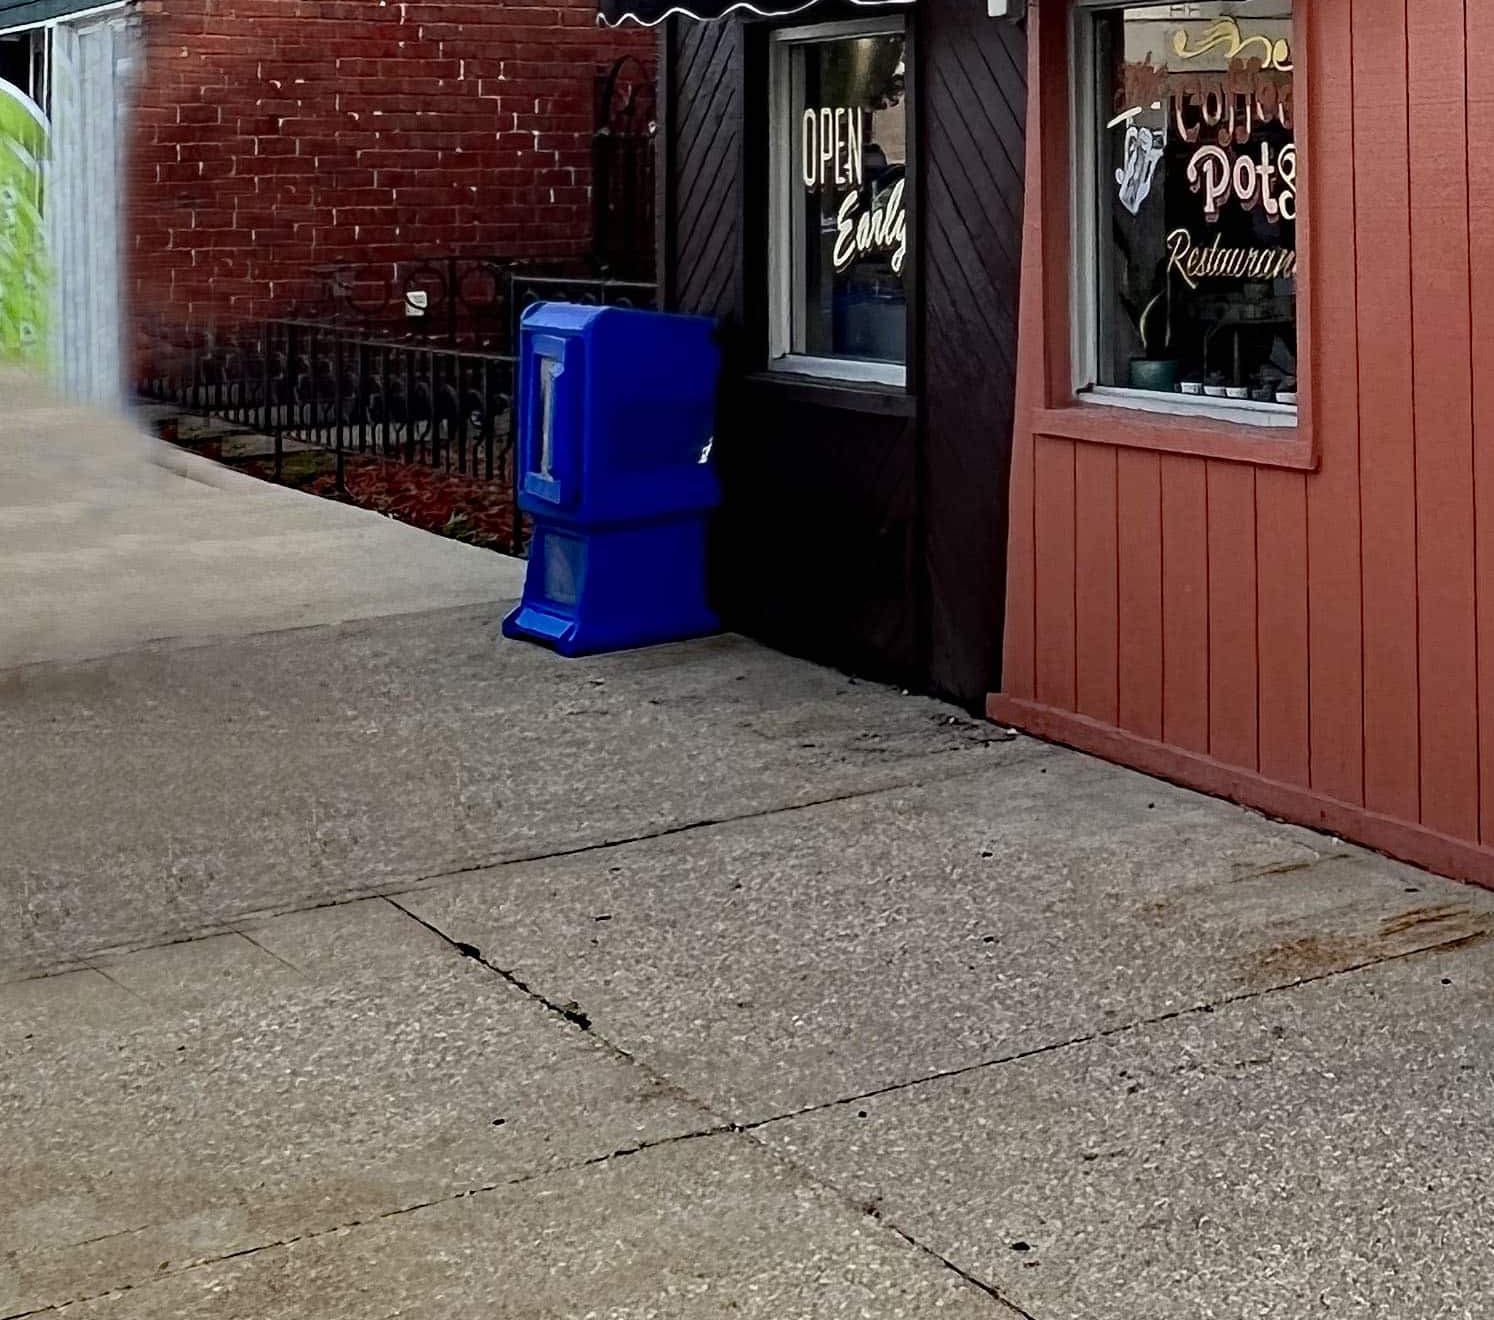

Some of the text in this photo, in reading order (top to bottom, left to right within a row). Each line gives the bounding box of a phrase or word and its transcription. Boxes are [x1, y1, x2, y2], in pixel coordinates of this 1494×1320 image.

[802, 106, 863, 187] OPEN
[833, 178, 906, 273] Early
[1167, 228, 1297, 289] Restauran
